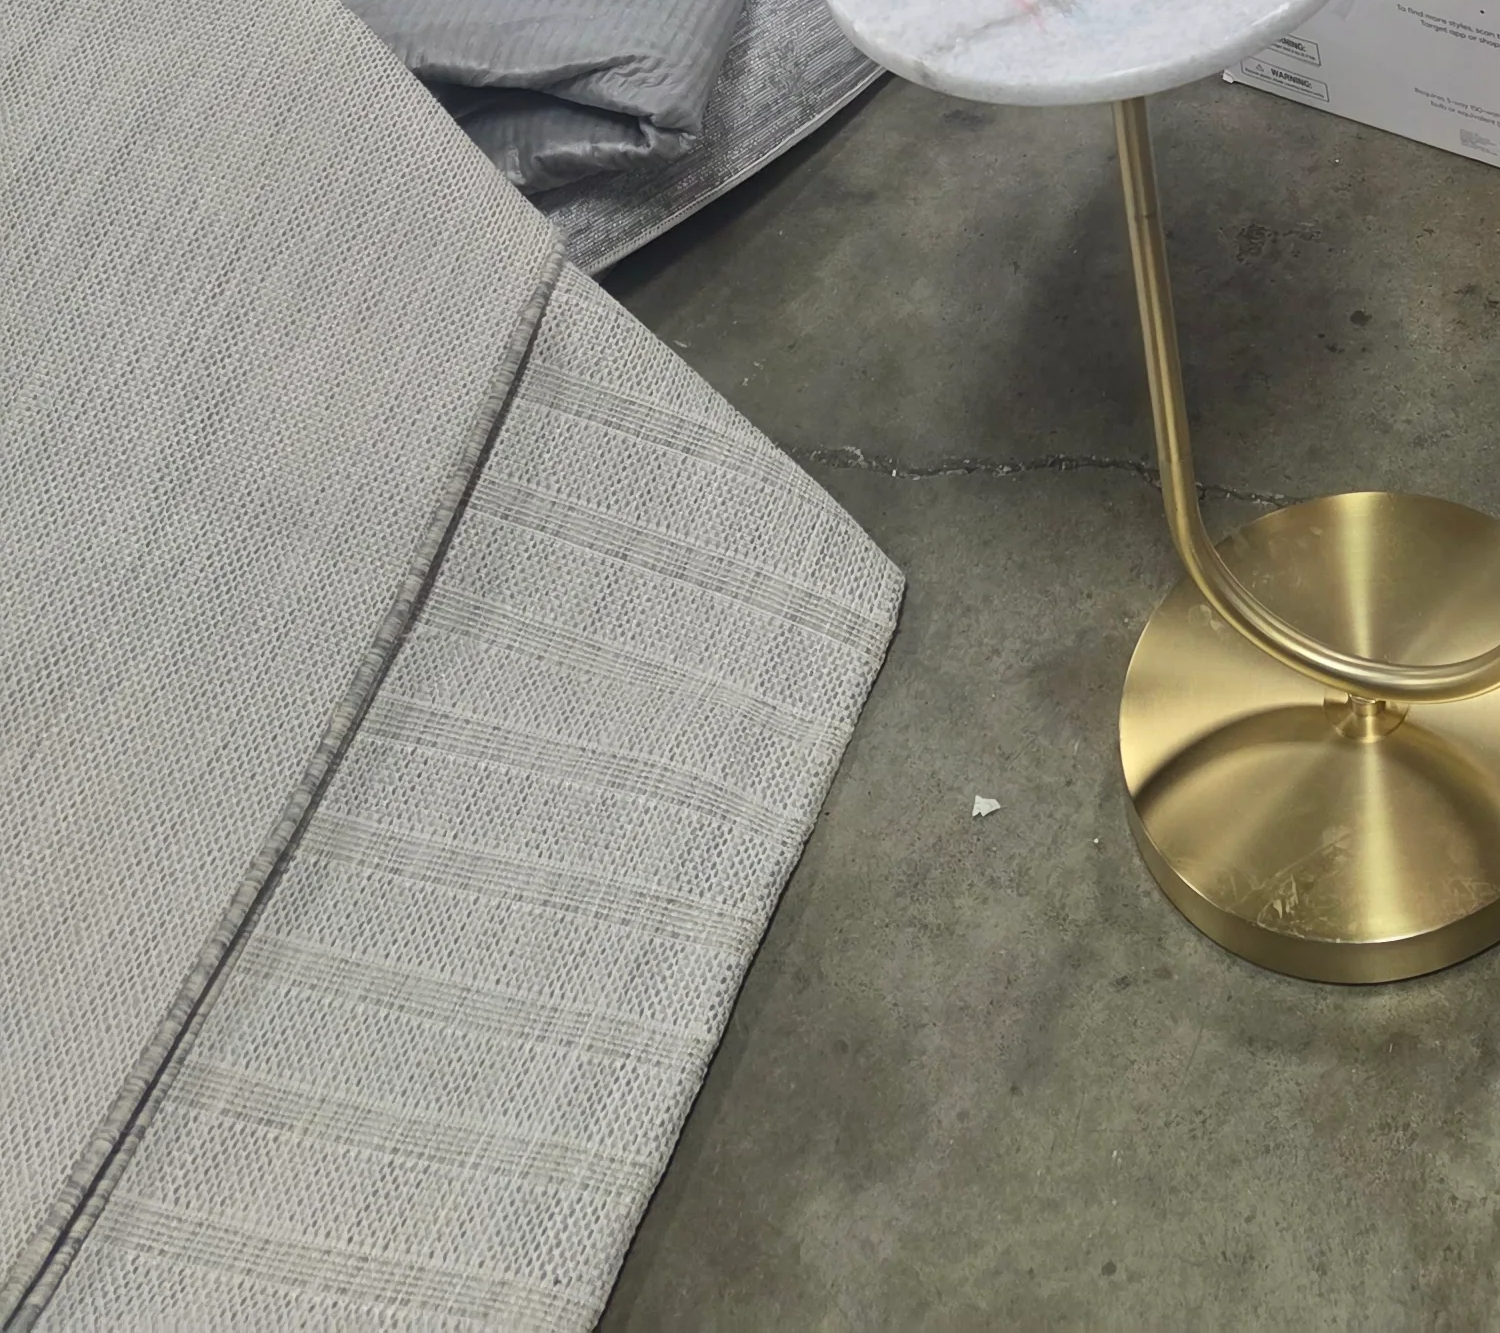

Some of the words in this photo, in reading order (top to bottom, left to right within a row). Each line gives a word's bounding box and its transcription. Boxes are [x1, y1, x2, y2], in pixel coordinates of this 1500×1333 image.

[1396, 4, 1406, 13] To
[1408, 7, 1424, 18] find
[1425, 13, 1447, 24] more
[1475, 27, 1495, 38] scan
[1281, 37, 1306, 52] NING:
[1420, 20, 1448, 34] Target
[1449, 29, 1466, 40] app
[1479, 37, 1500, 49] shop
[1271, 68, 1312, 89] WARNING:
